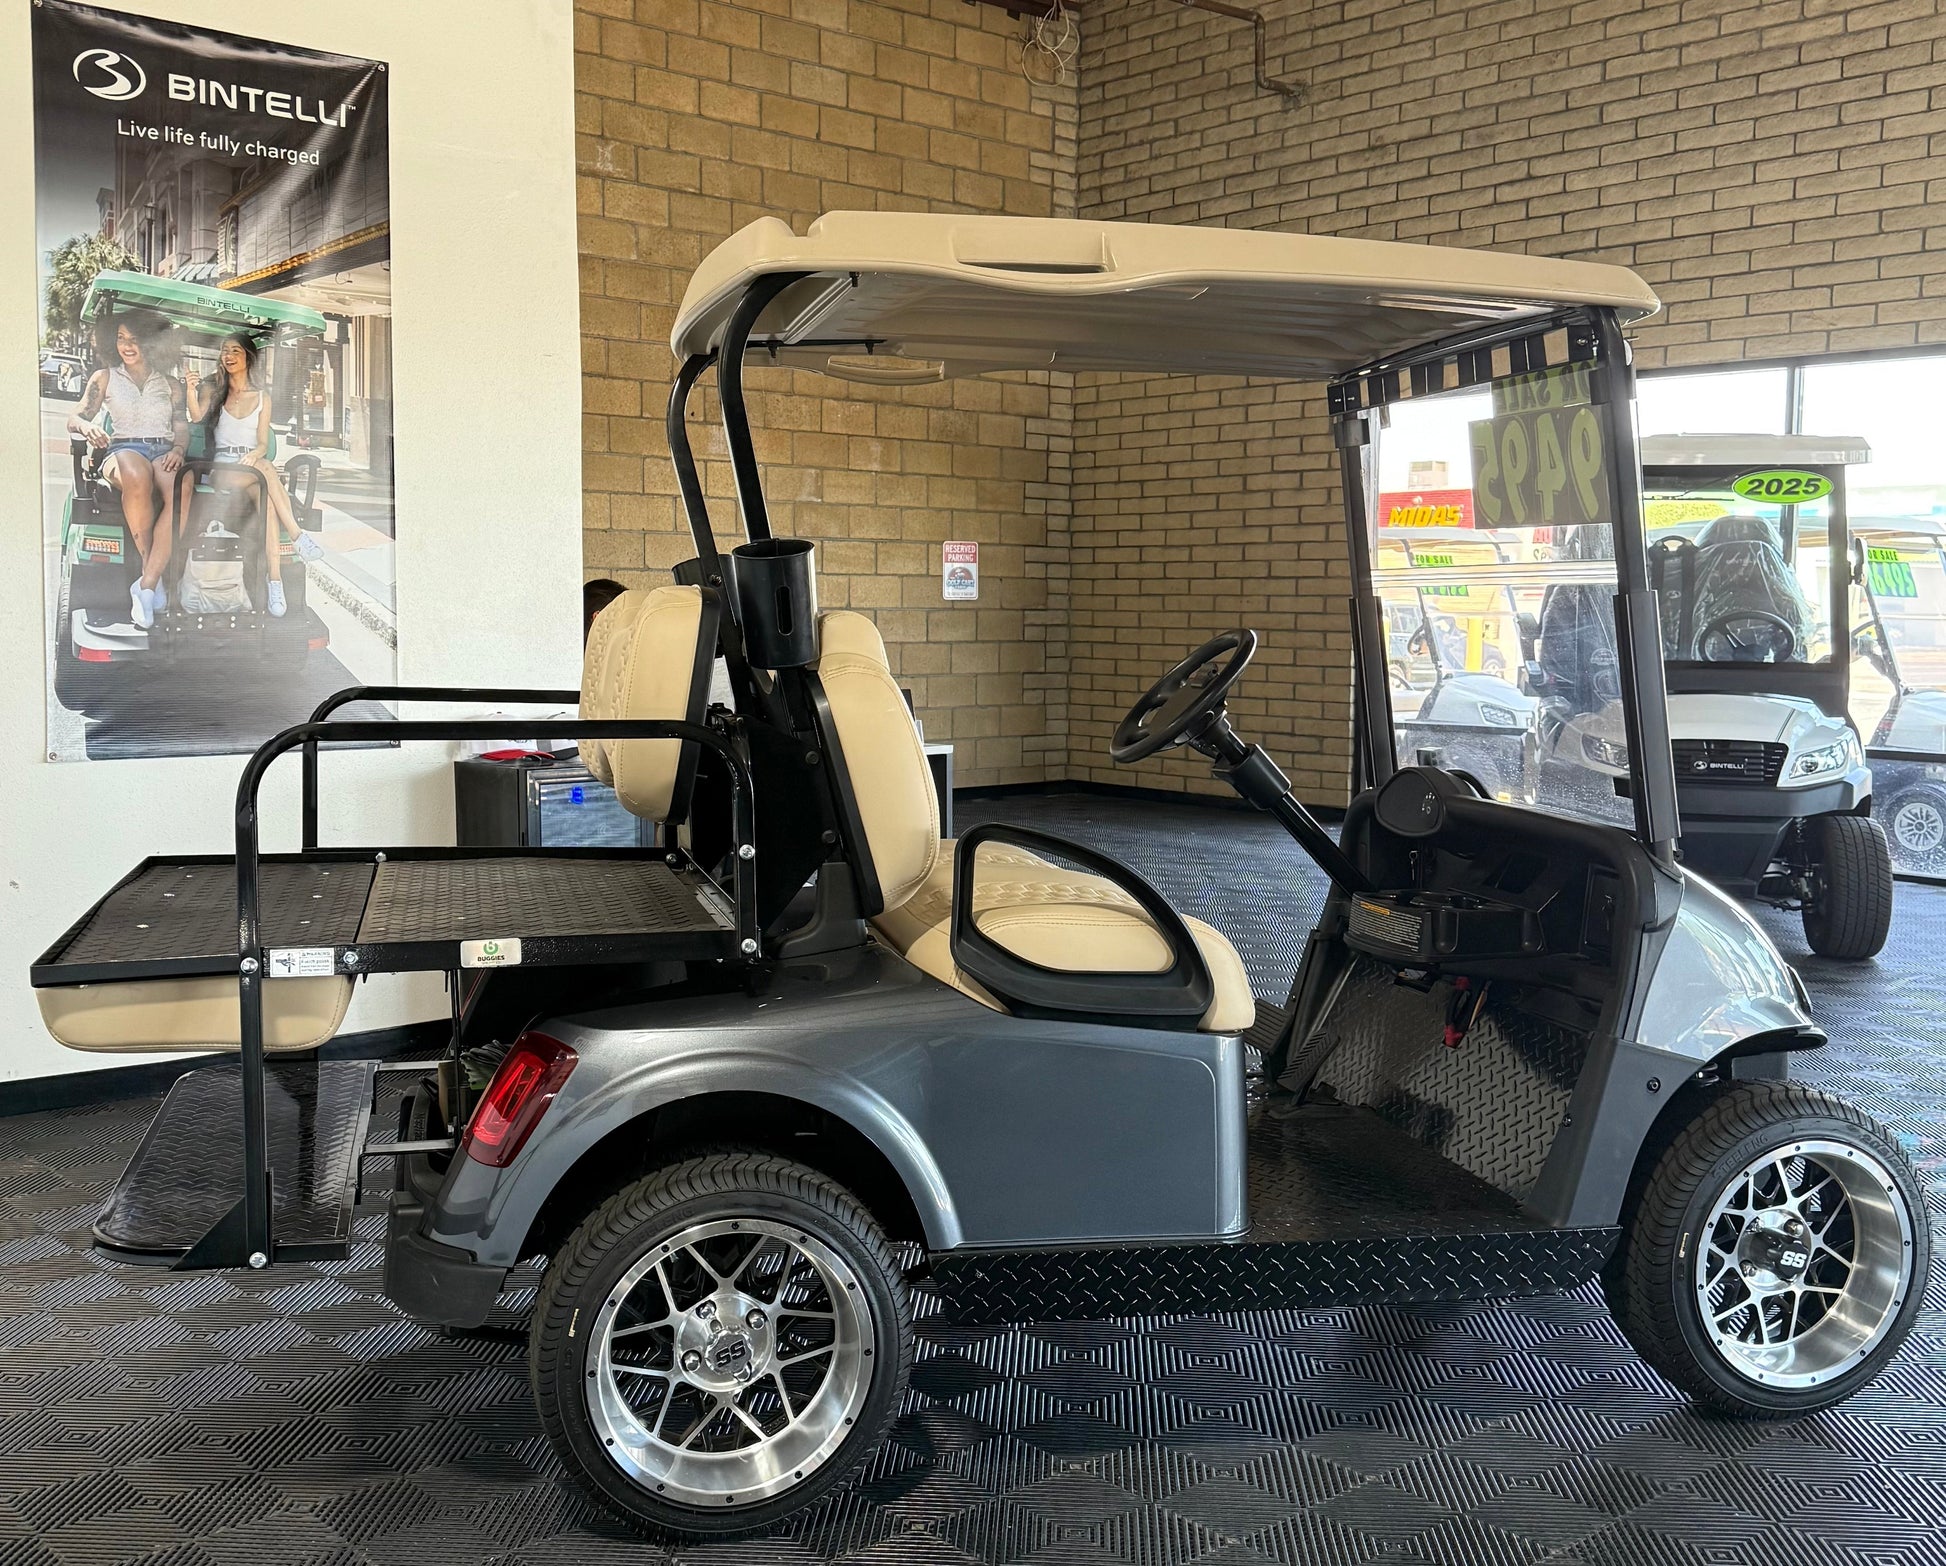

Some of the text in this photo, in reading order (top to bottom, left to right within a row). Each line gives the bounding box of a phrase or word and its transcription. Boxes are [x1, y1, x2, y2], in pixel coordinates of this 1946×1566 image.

[167, 73, 347, 128] BINTELLI
[117, 119, 320, 166] Live life fully charged
[197, 297, 250, 313] BINTELLI
[1744, 477, 1822, 496] 2025
[1388, 505, 1462, 528] MIDAS
[945, 544, 976, 553] RESERVED
[947, 553, 974, 562] PARKING
[1880, 550, 1899, 561] SALE
[1415, 554, 1454, 565] FOR SALE
[1780, 1250, 1807, 1268] SS
[716, 1340, 746, 1368] SS
